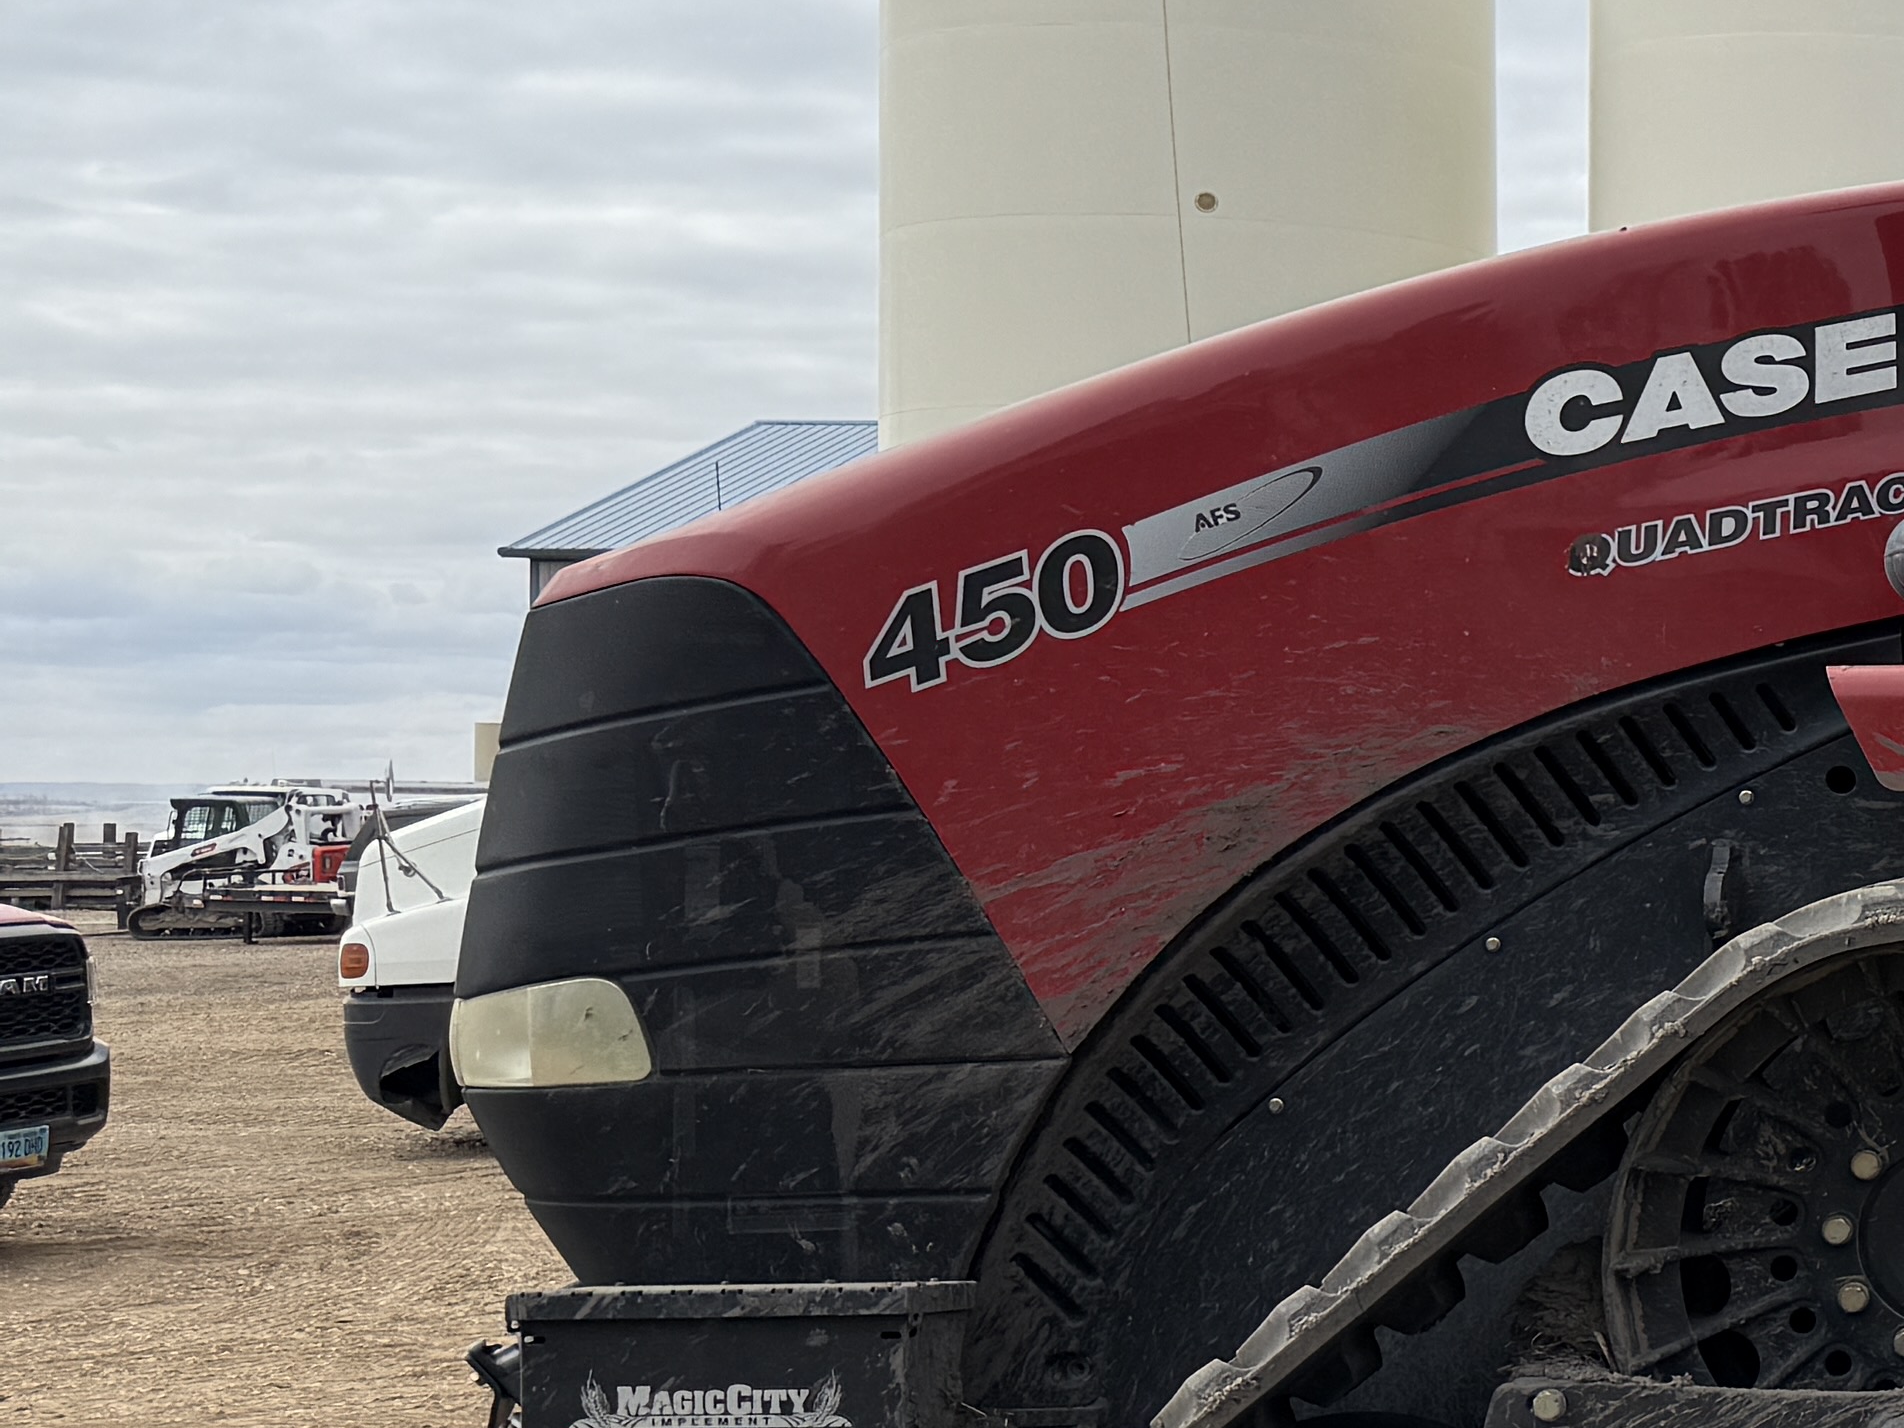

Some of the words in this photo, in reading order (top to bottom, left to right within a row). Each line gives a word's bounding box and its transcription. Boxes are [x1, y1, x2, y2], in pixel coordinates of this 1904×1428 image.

[1524, 312, 1898, 456] CASE
[1194, 502, 1242, 533] AFS
[863, 528, 1125, 693] 450
[652, 1416, 772, 1427] IMPLEMENT
